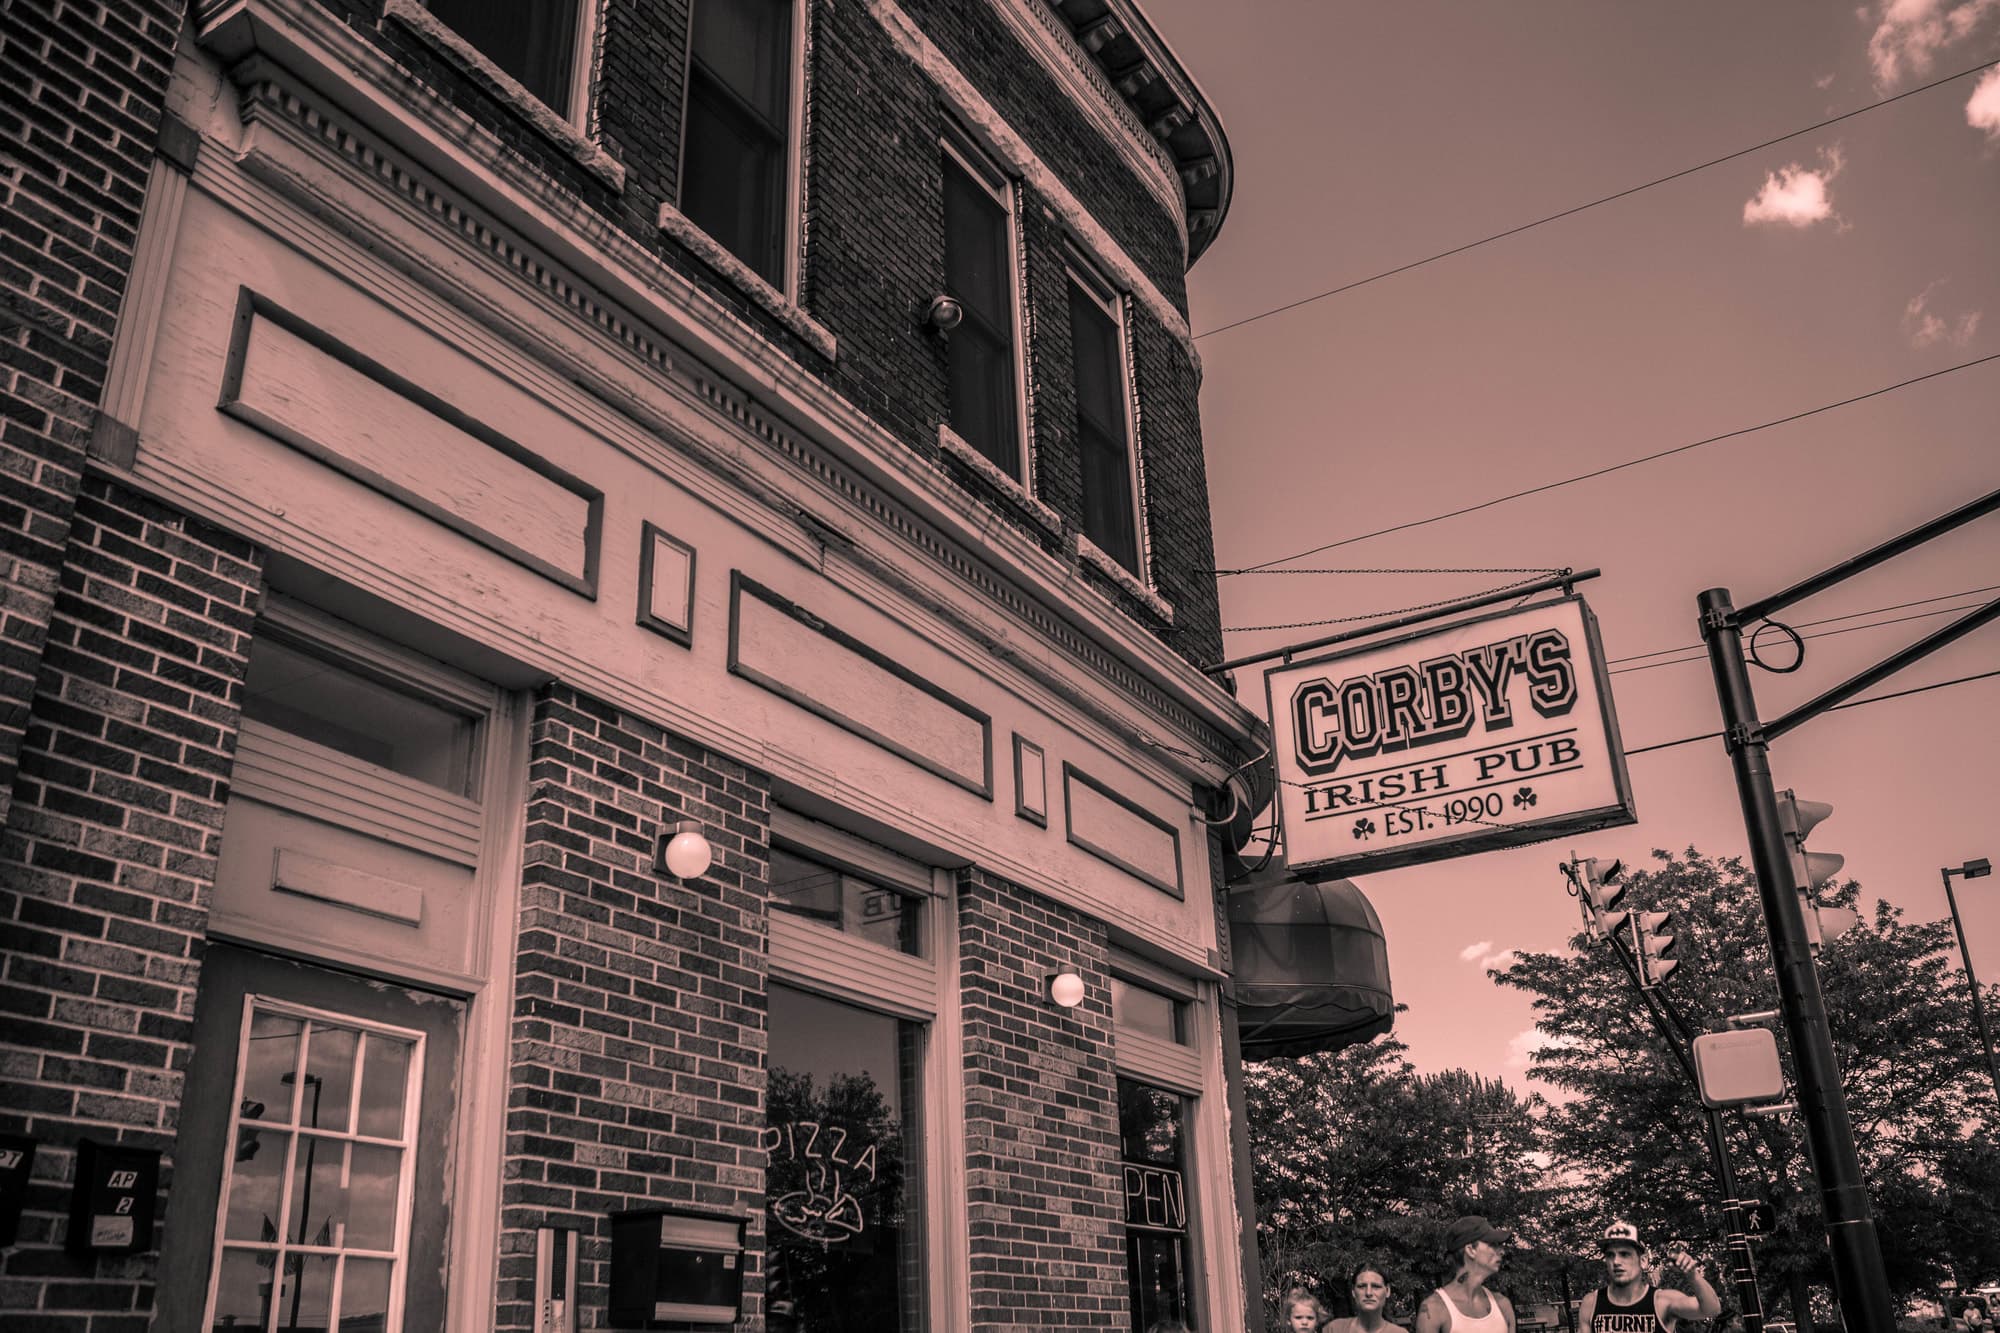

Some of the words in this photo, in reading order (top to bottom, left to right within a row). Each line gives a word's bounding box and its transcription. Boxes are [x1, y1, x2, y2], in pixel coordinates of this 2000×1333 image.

[1291, 628, 1578, 776] CORBY'S
[1304, 764, 1450, 814] IRISH
[1474, 738, 1581, 781] PUB
[1385, 805, 1434, 837] EST.
[1442, 792, 1503, 826] 1990
[766, 1121, 876, 1182] PIZZA
[118, 1198, 131, 1212] 2
